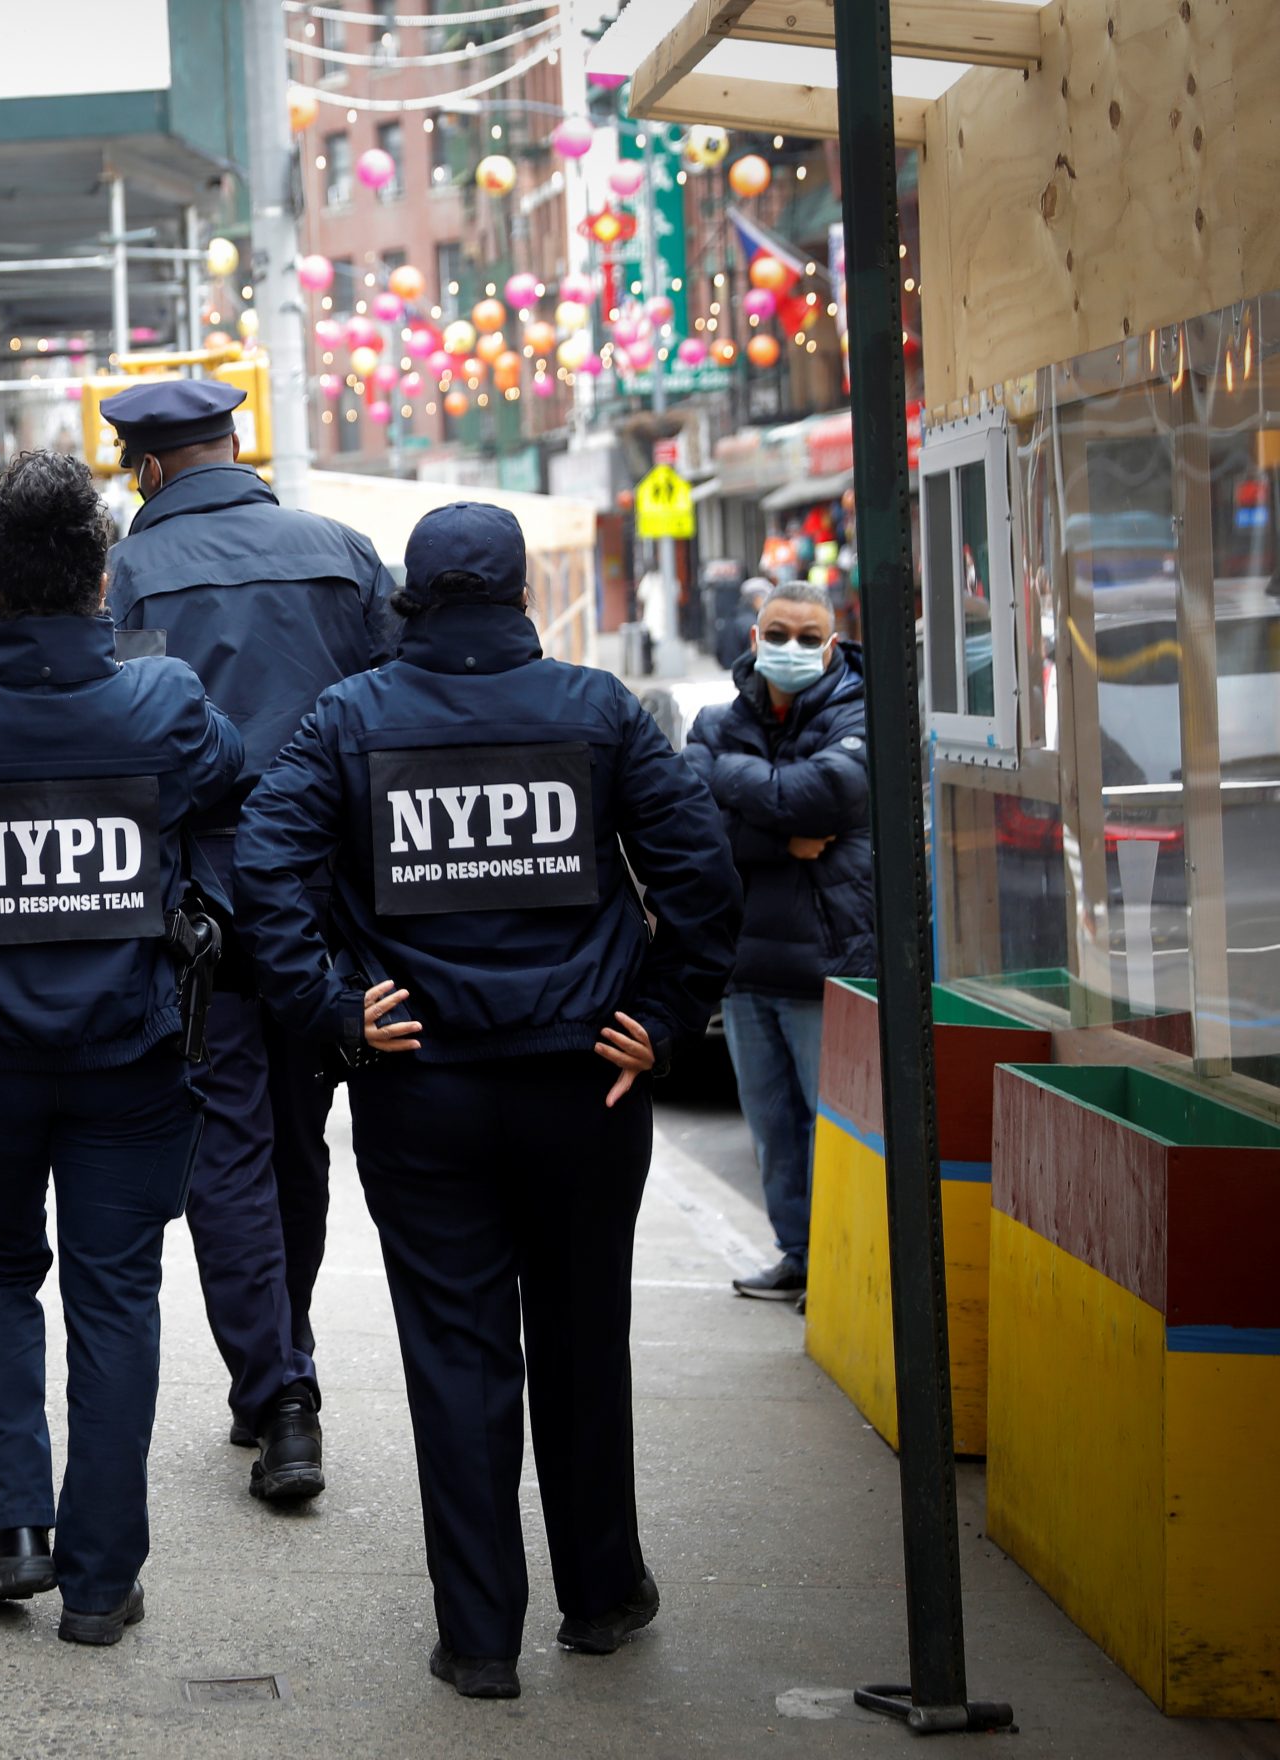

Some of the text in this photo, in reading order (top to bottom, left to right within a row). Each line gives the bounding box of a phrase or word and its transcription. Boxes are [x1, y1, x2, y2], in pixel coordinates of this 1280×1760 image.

[387, 781, 577, 853] NYPD
[391, 855, 580, 883] RAPID RESPONSE TEAM
[19, 894, 100, 914] RESPONSE
[103, 892, 145, 909] TEAM
